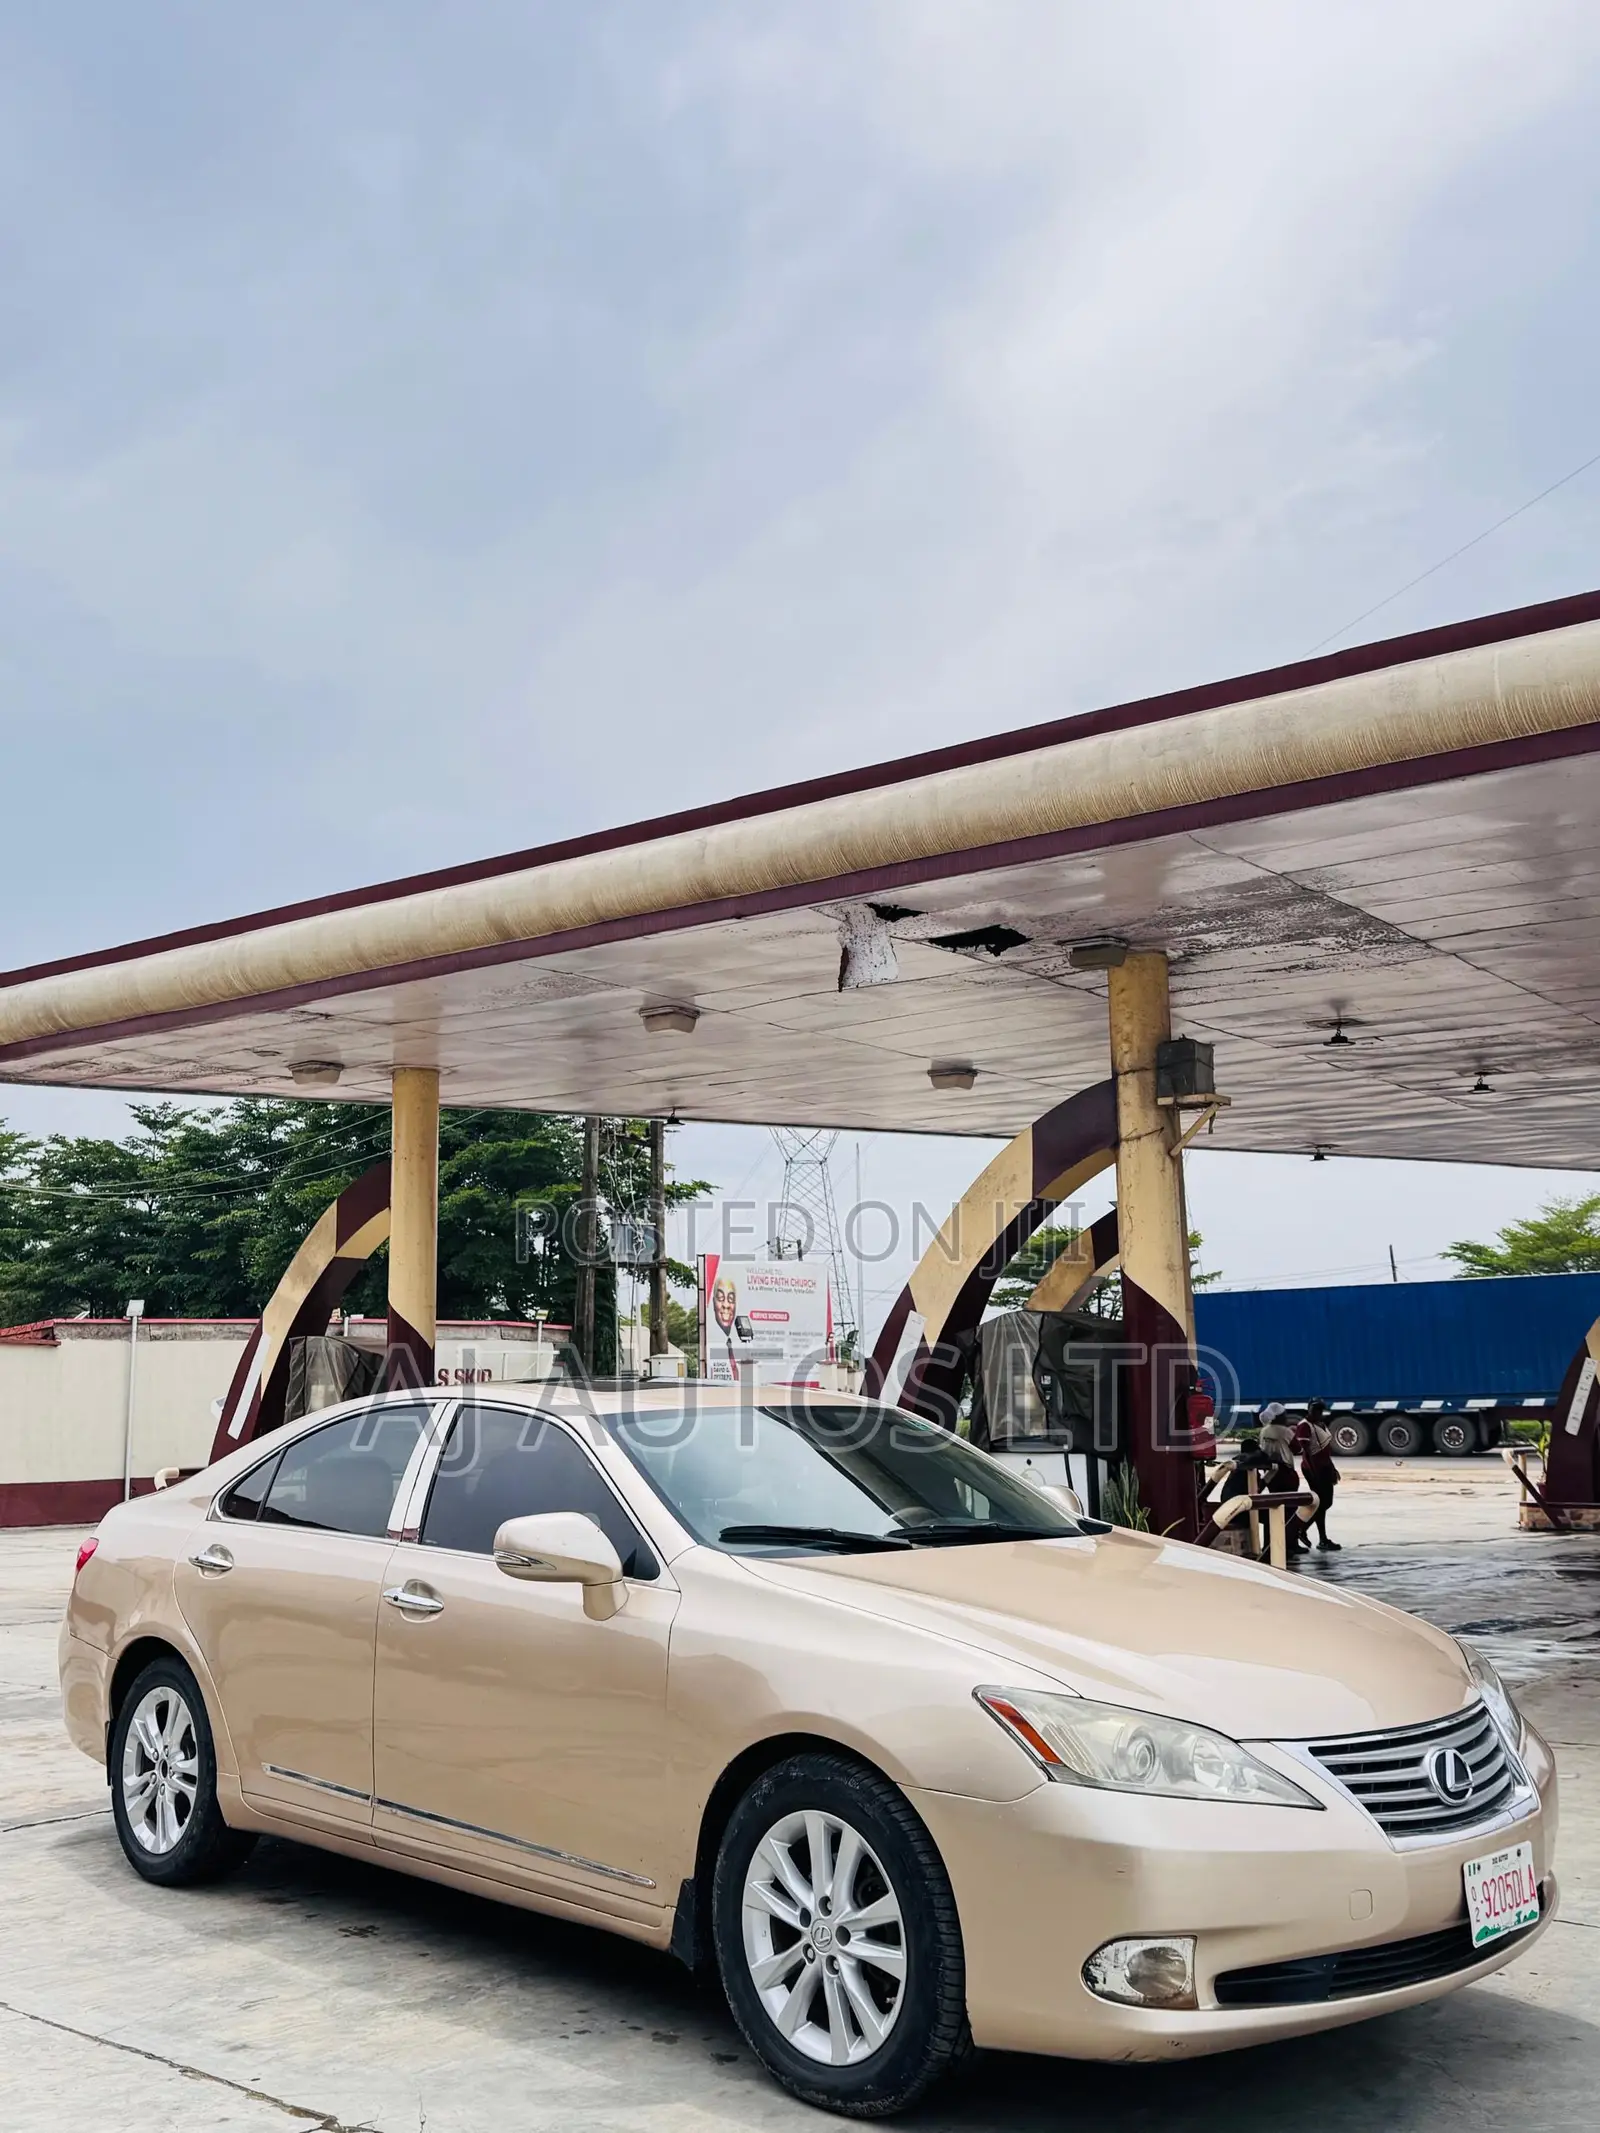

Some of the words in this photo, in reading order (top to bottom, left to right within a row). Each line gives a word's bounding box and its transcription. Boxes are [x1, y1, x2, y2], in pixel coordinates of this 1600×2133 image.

[747, 1275, 769, 1285] LIVING
[770, 1276, 789, 1287] FAITH
[790, 1278, 816, 1289] CHURCH
